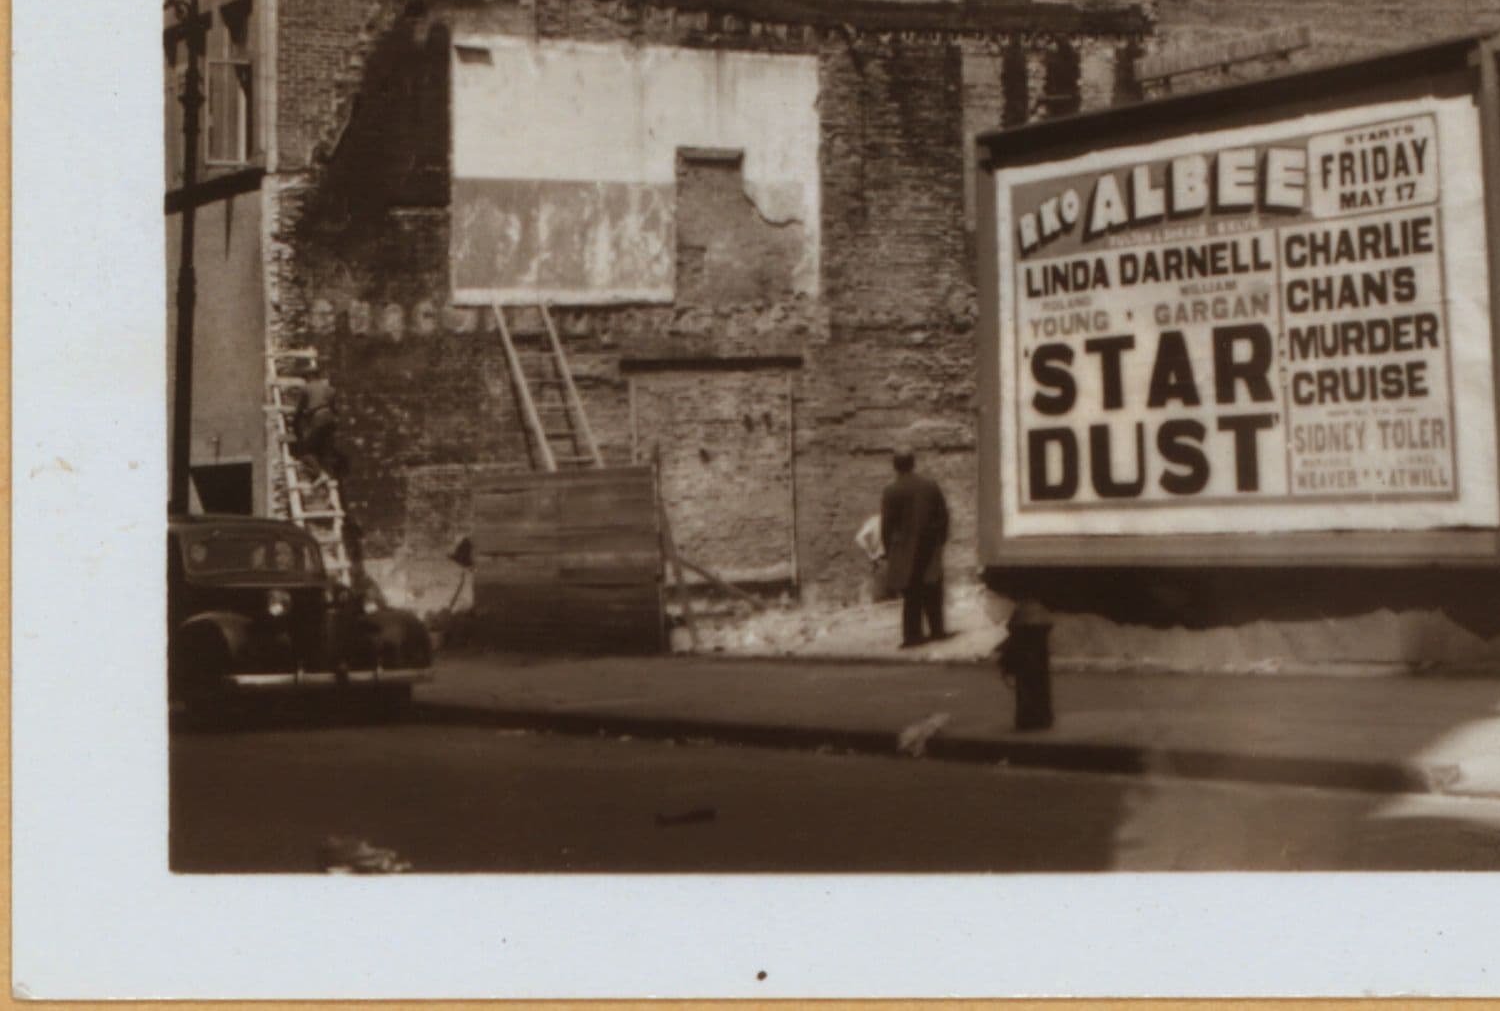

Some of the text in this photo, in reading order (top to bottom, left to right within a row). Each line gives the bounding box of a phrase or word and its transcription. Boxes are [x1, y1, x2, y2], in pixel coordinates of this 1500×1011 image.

[1321, 137, 1427, 190] FRIDAY
[1020, 148, 1306, 258] RKO ALBEE
[1340, 182, 1416, 210] MAY 17
[1285, 217, 1433, 269] CHARLIE
[1025, 237, 1272, 299] LINDA DARNELL
[1179, 280, 1238, 297] WILLIAM
[1287, 266, 1417, 314] CHAN'S
[1029, 310, 1111, 339] YOUNG
[1154, 293, 1270, 327] GARGAN
[1289, 313, 1439, 362] MURDER
[1291, 362, 1429, 407] CRUISE
[1294, 417, 1446, 455] SIDNEY TOLER
[1388, 468, 1449, 488] ATWILL
